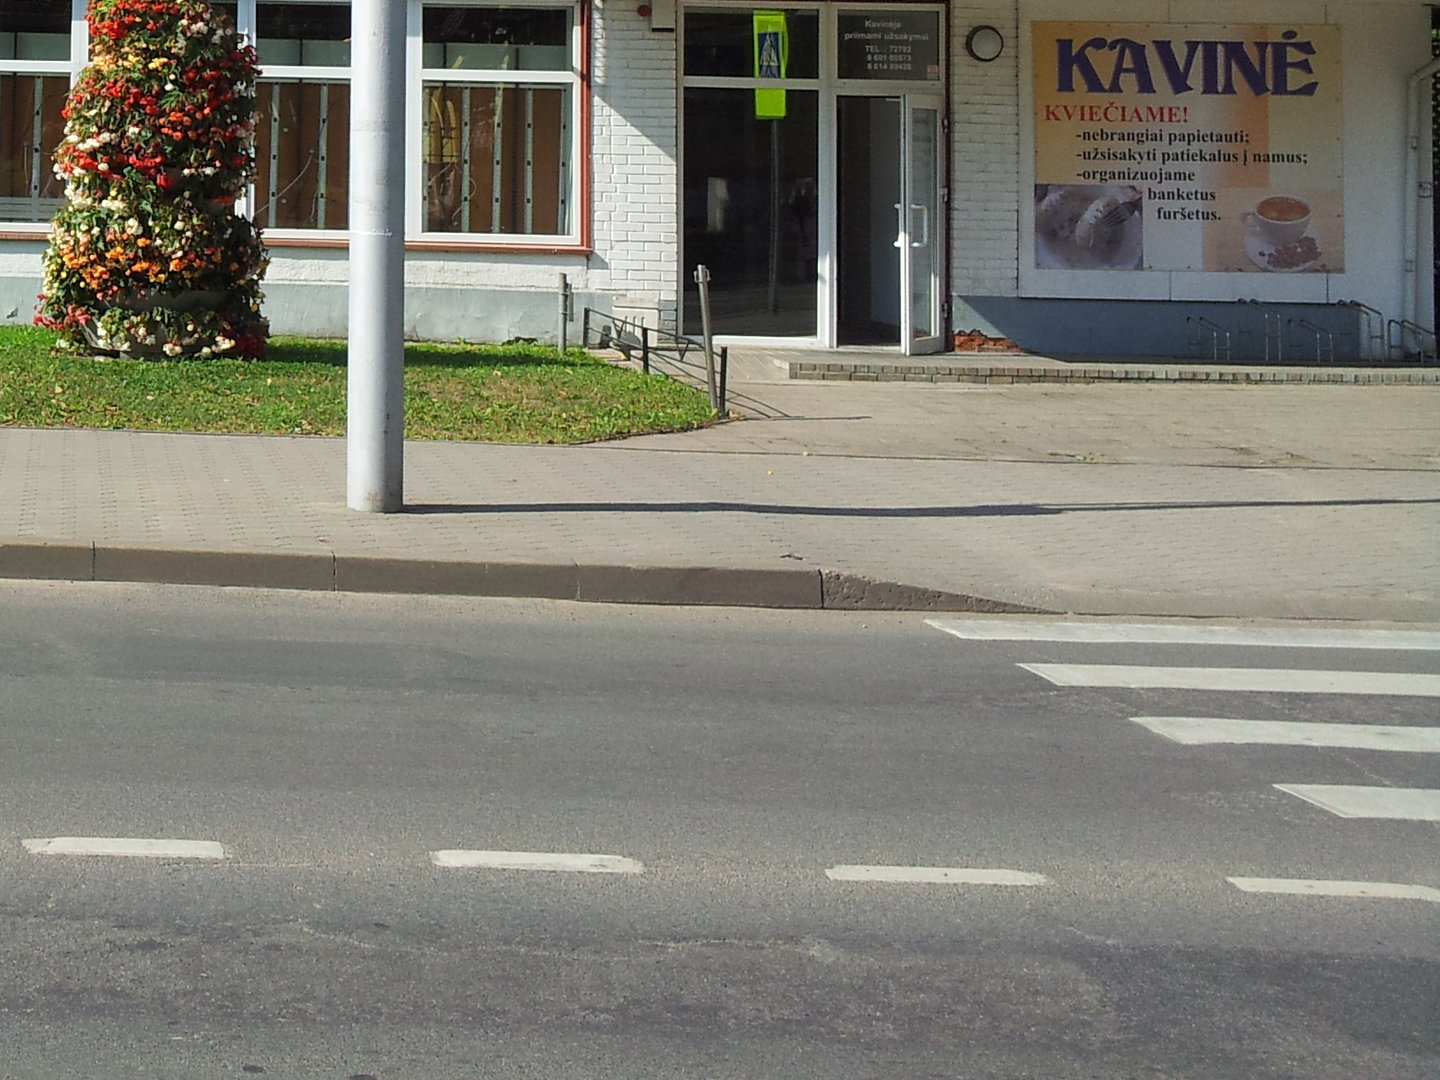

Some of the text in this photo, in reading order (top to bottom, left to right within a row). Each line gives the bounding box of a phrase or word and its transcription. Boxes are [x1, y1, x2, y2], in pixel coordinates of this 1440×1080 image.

[1056, 30, 1319, 97] KAVINĖ
[1044, 101, 1188, 123] KVIEČIAME!
[1075, 128, 1250, 146] -nebrangiai papietauti;
[1075, 147, 1157, 164] -užsisakyti
[1161, 149, 1239, 165] patiekalus
[1252, 153, 1308, 165] namus;
[1075, 169, 1196, 184] -organizuojame
[1147, 187, 1216, 201] banketus
[1156, 207, 1222, 221] furšetus.
